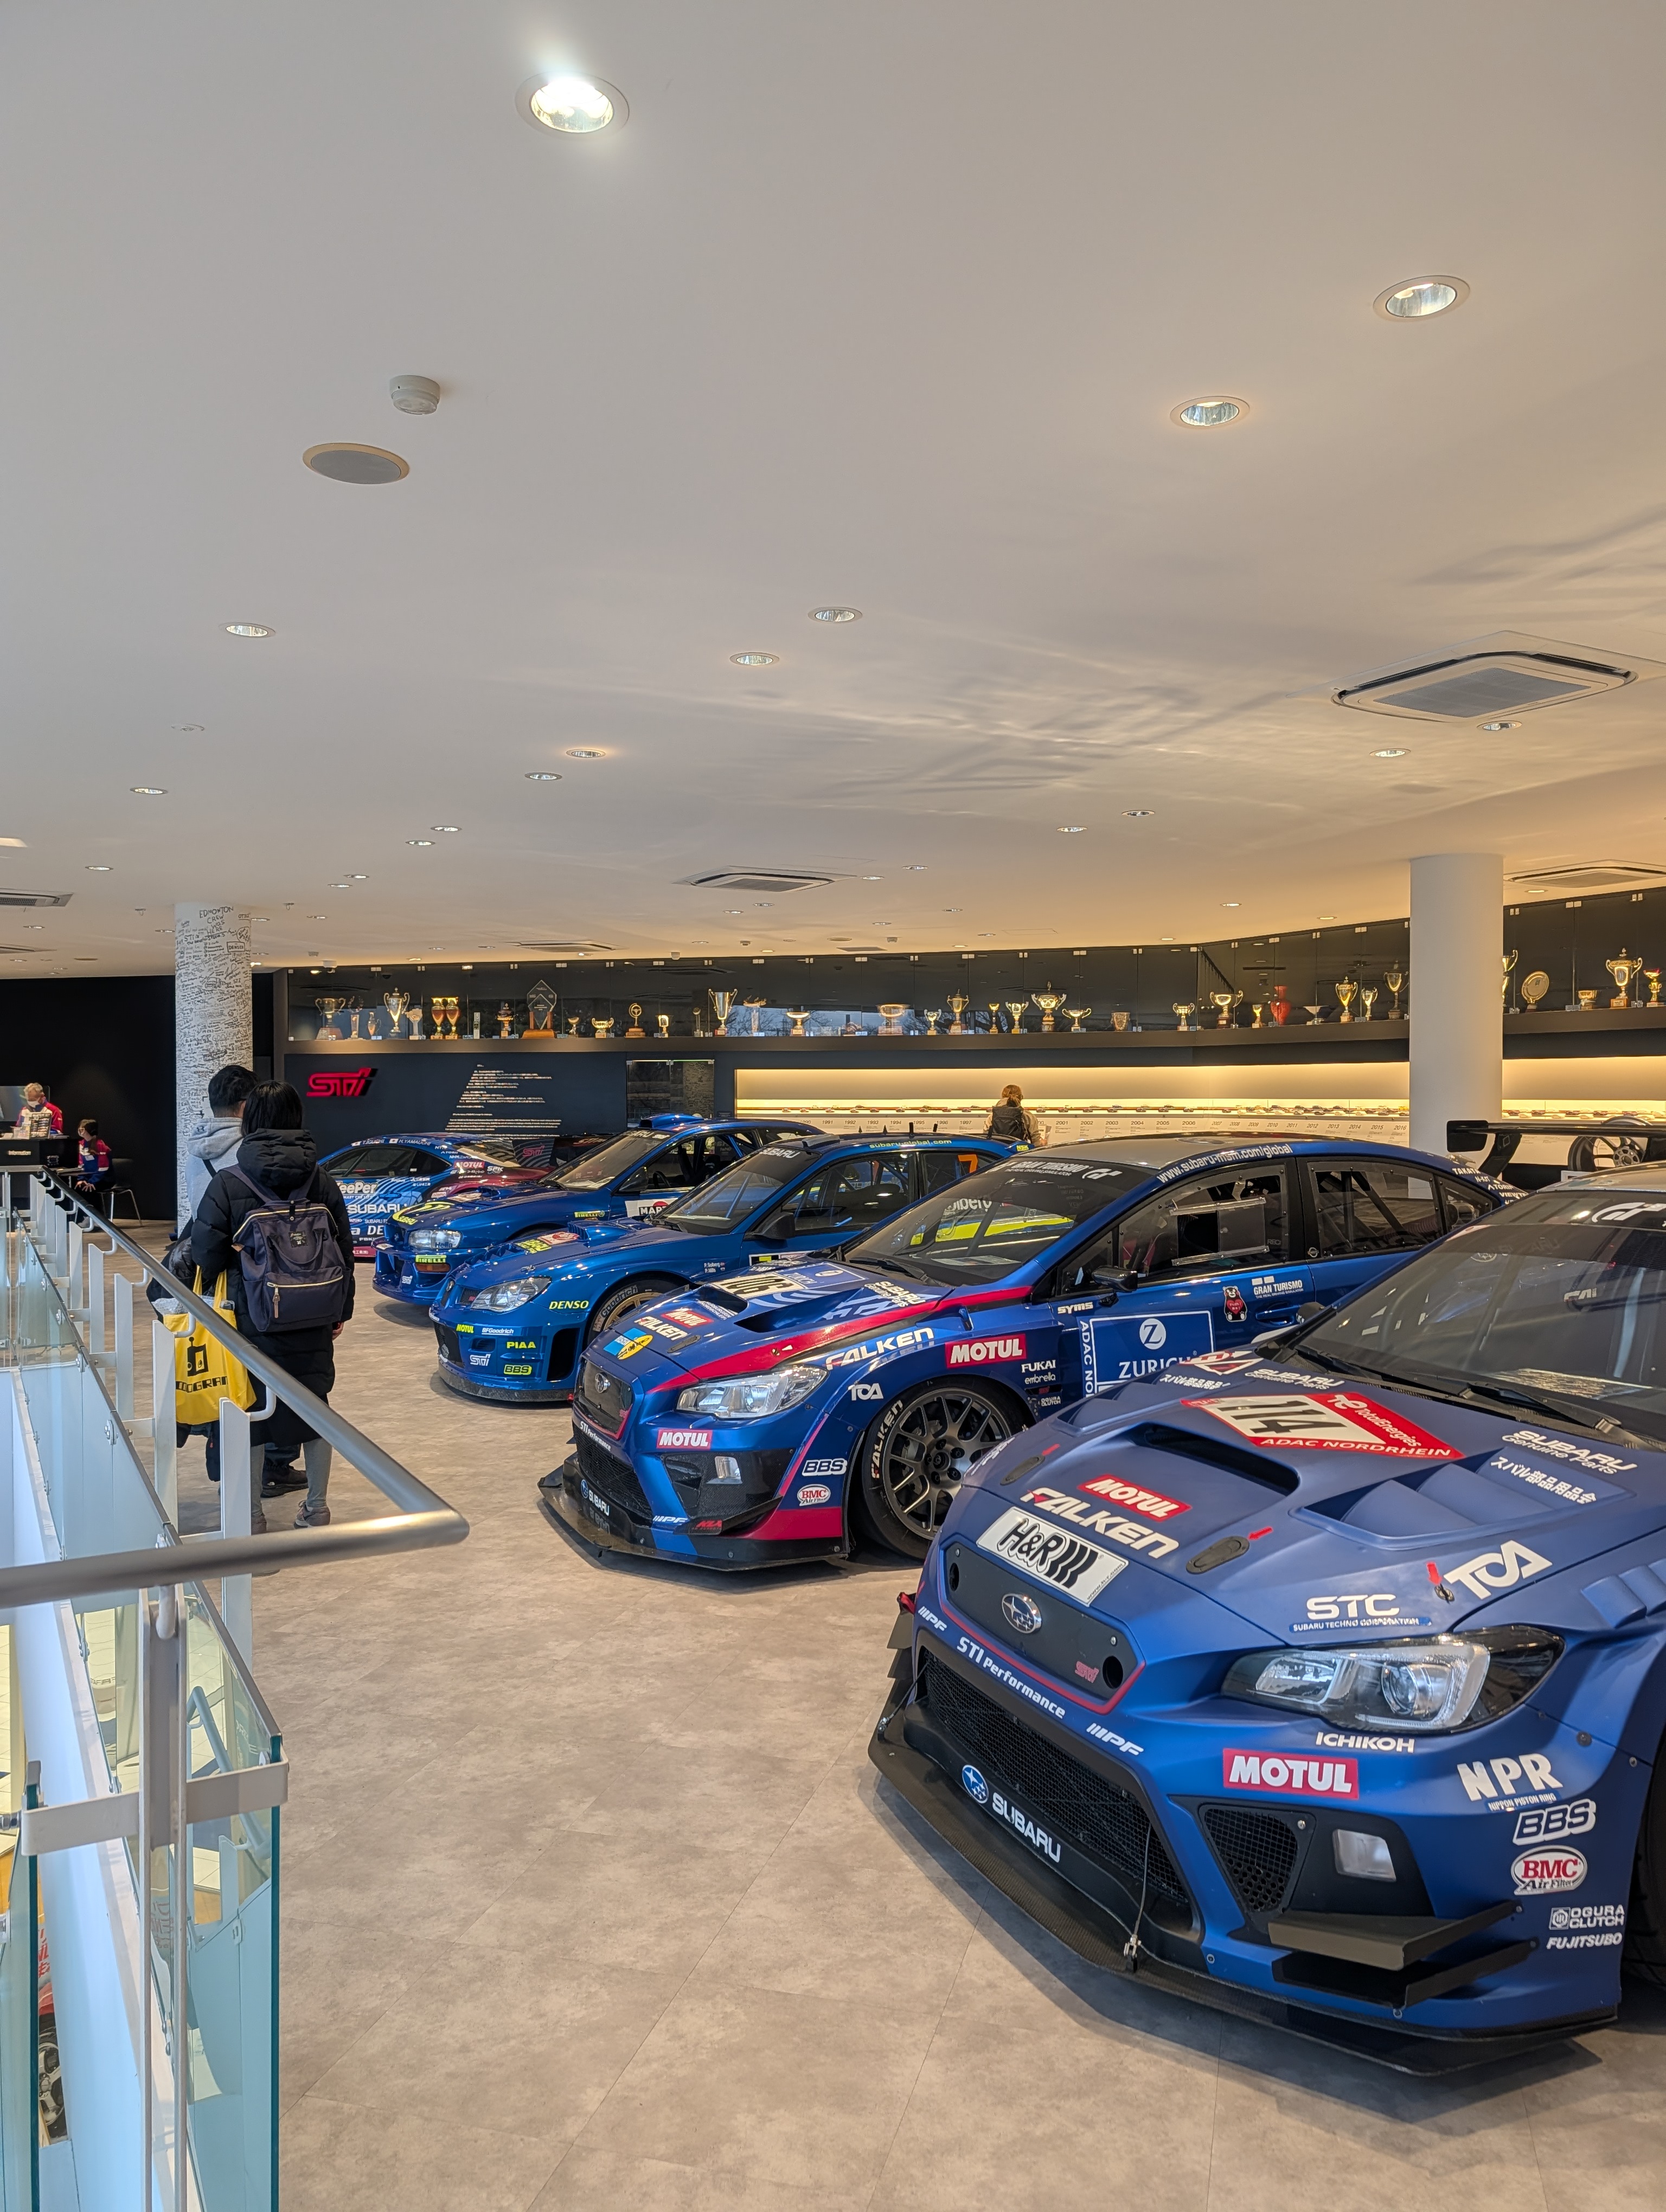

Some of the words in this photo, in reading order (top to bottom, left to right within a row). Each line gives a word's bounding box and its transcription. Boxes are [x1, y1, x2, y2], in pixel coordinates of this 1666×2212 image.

[200, 906, 234, 918] EDMONTON
[415, 1255, 446, 1263] PIRELLI
[875, 1281, 926, 1304] SUBARU
[1253, 1284, 1272, 1295] GRAN
[1274, 1280, 1303, 1292] TURISMO
[549, 1300, 589, 1310] DENSO
[634, 1316, 688, 1341] FALKEN
[664, 1309, 707, 1327] MOTUL
[456, 1324, 474, 1334] MOTUL
[825, 1327, 934, 1371] FALKEN
[950, 1338, 1023, 1364] MOTUL
[1079, 1321, 1092, 1365] ADAC
[504, 1365, 531, 1374] BBS
[1021, 1360, 1056, 1373] FUKAI
[1024, 1372, 1056, 1384] embrella
[1254, 1368, 1345, 1387] SUBARU
[1354, 1407, 1421, 1448] TotalEnergies
[587, 1429, 611, 1451] Performance
[659, 1431, 709, 1447] MOTUL
[871, 1399, 904, 1479] FALKEN
[1260, 1437, 1320, 1448] ADAC
[1322, 1441, 1451, 1457] NORDRHEIN
[1502, 1435, 1568, 1459] Genuine
[1569, 1453, 1618, 1475] Parts
[1513, 1430, 1638, 1471] SUBARU
[804, 1459, 845, 1474] BBS
[1490, 1456, 1598, 1504] スバル部品用品会
[588, 1489, 610, 1516] SUBARU
[802, 1489, 826, 1499] BMC
[1085, 1478, 1180, 1518] MOTUL
[1020, 1487, 1180, 1559] FALKEN
[998, 1519, 1071, 1574] H&R
[1443, 1540, 1553, 1600] TOA
[1306, 1594, 1400, 1620] STC
[1293, 1621, 1324, 1631] SUBARU
[1325, 1619, 1359, 1629] TECHNO
[1360, 1617, 1419, 1626] CORPORATION
[957, 1636, 985, 1664] STI
[983, 1657, 1066, 1719] Performance
[1316, 1732, 1415, 1753] ICHIKOH
[1229, 1755, 1353, 1793] MOTUL
[1457, 1753, 1563, 1802] NPR
[1488, 1799, 1514, 1811] NIPPON
[1515, 1795, 1539, 1807] PISTON
[1539, 1792, 1556, 1804] RING
[992, 1792, 1061, 1863] SUBARU
[1517, 1800, 1593, 1841] BBS
[1521, 1859, 1578, 1879] BMC
[1523, 1879, 1548, 1891] Air
[1550, 1878, 1573, 1888] Filter
[1569, 1914, 1625, 1929] CLUTCH
[1571, 1904, 1625, 1918] OGURA
[1546, 1932, 1623, 1950] FUJITSUBO
